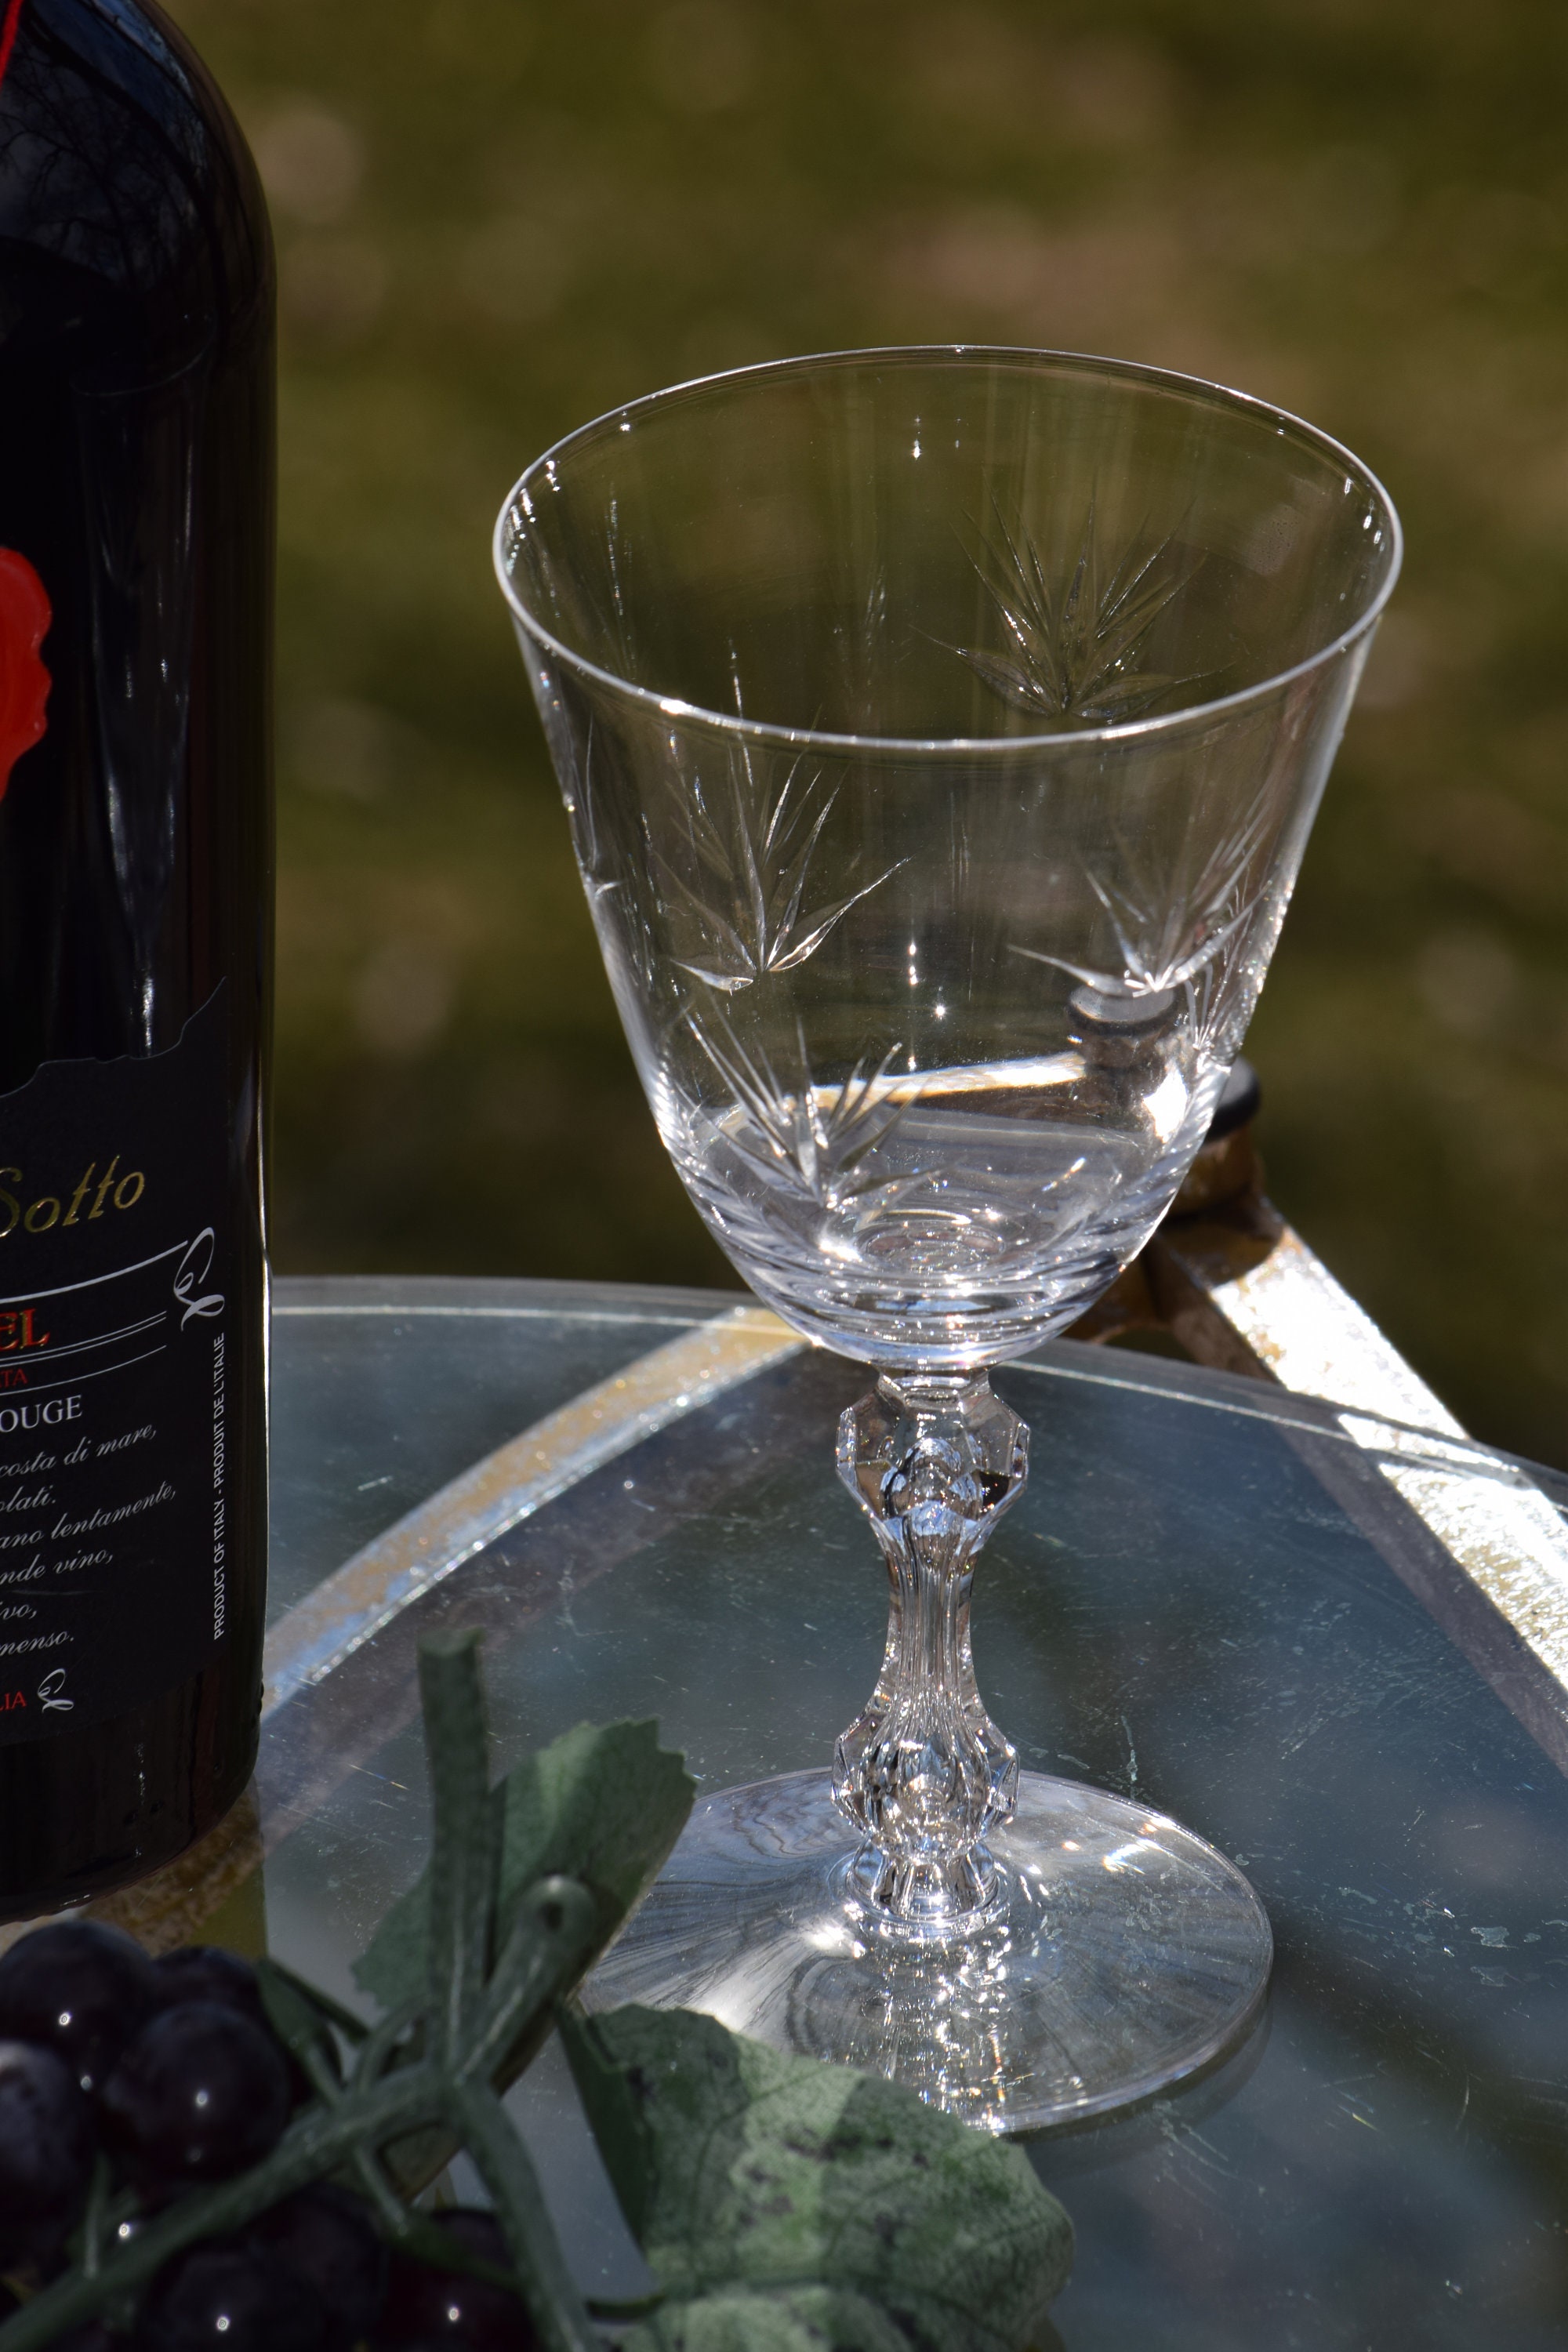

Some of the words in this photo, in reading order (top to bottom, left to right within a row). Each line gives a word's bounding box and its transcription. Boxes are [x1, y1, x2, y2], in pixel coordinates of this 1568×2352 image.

[0, 1368, 29, 1388] TA
[213, 1332, 225, 1396] L'ITALIE
[0, 1394, 83, 1433] OUGE
[213, 1393, 225, 1419] DE
[63, 1436, 93, 1465] di
[96, 1424, 157, 1457] mare,
[213, 1420, 225, 1488] PRODUIT
[50, 1479, 176, 1540] lentamente,
[213, 1498, 225, 1541] ITALY
[53, 1548, 114, 1574] vino,
[213, 1541, 225, 1564] OF
[213, 1565, 225, 1640] PRODUCT
